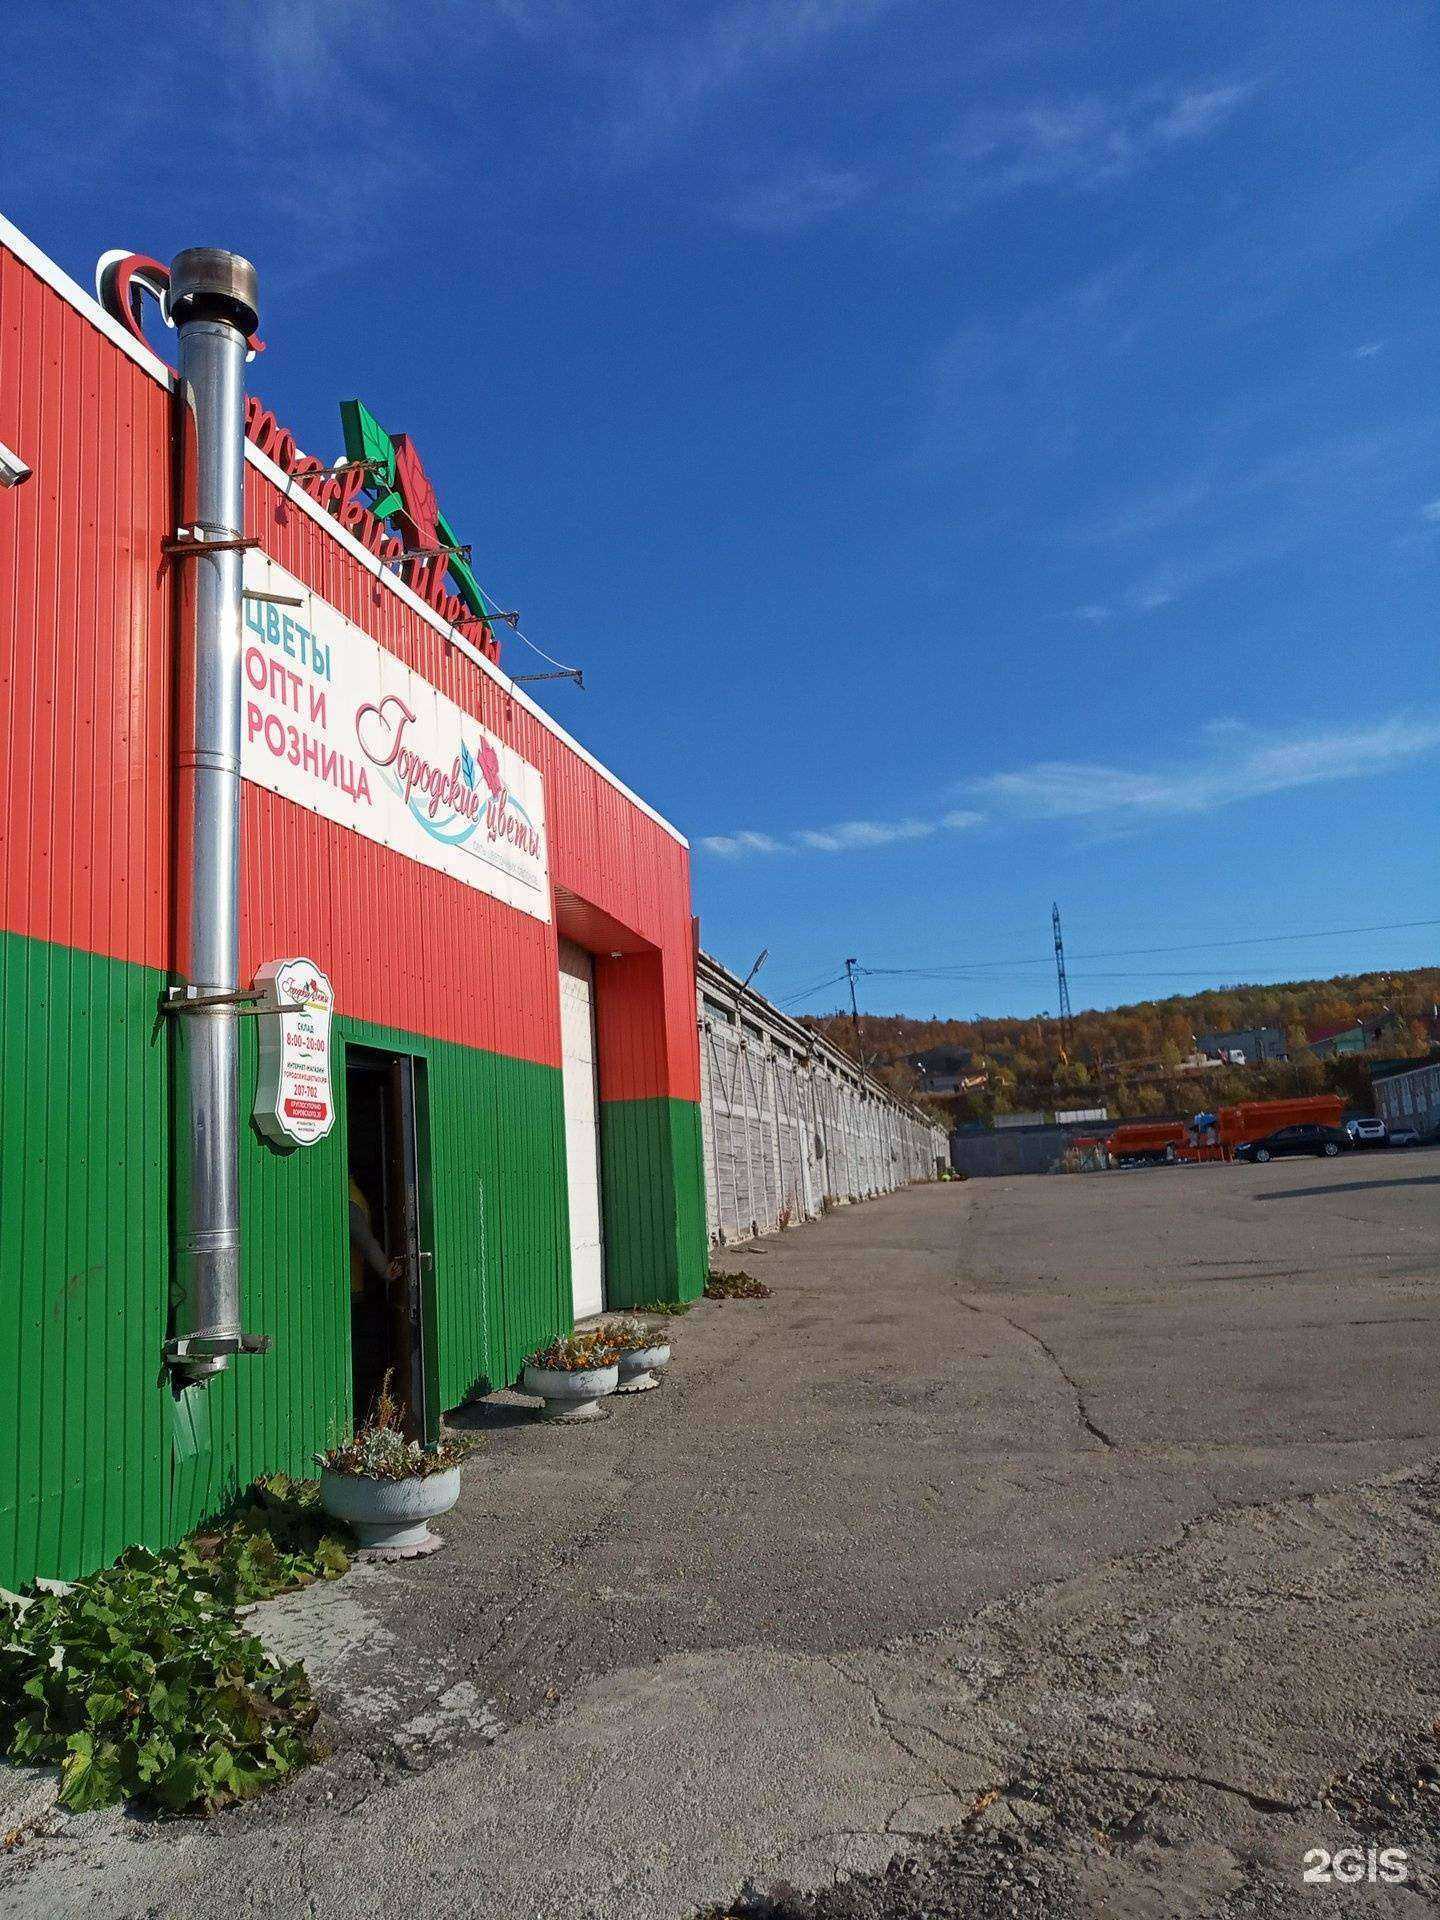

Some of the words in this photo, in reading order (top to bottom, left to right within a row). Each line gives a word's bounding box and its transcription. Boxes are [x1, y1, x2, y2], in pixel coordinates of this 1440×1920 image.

[245, 598, 332, 682] ЦВЕТЫ
[245, 646, 303, 713] ОПТ
[309, 685, 327, 730] И
[247, 701, 373, 806] РОЗНИЦА
[355, 694, 480, 822] Городские
[486, 788, 541, 861] цветы
